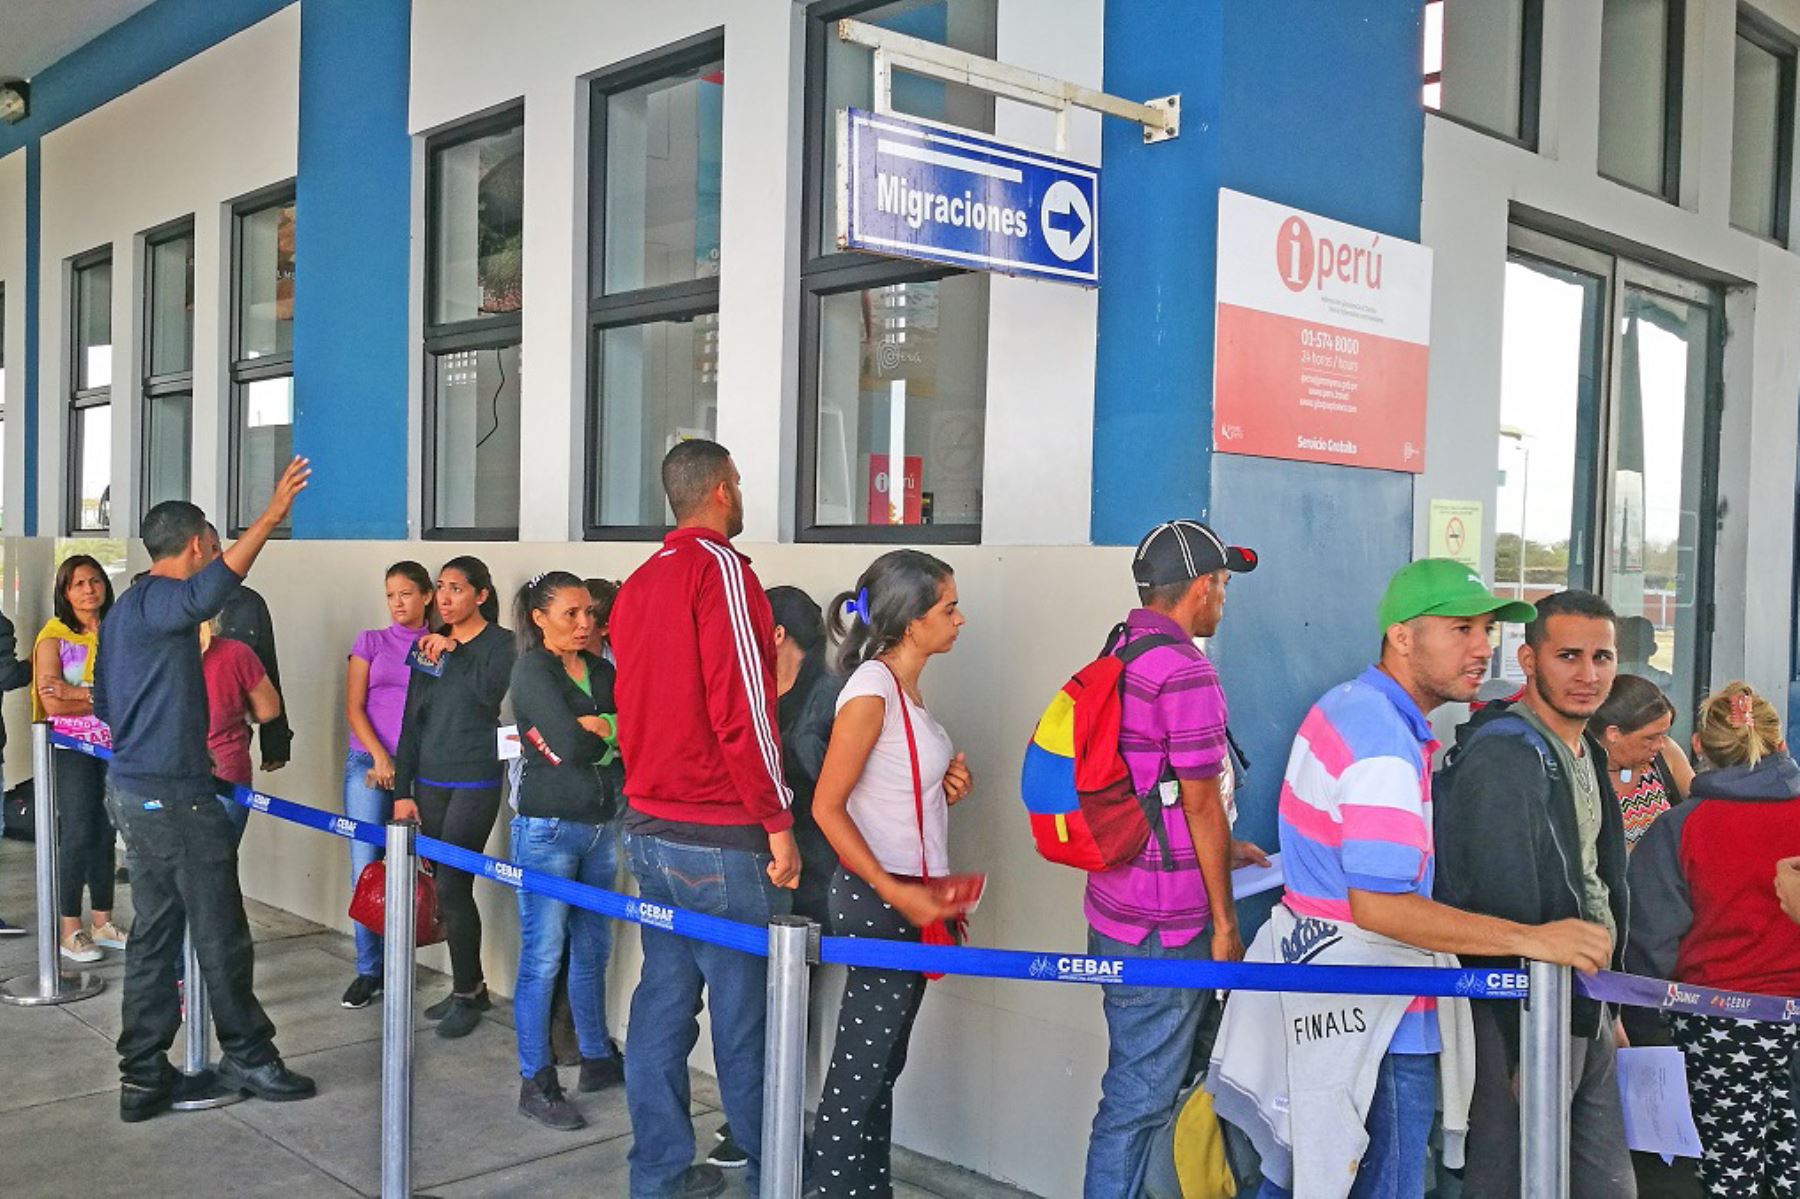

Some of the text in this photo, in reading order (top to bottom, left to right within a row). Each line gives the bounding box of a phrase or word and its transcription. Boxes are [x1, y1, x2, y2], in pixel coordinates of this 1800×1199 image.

[877, 173, 1028, 237] Migraciones
[1301, 328, 1360, 355] 01-574 8000
[495, 862, 522, 880] CEBAF
[640, 902, 673, 920] CEBAF
[1057, 958, 1124, 975] CEBAF
[1486, 973, 1529, 989] CEB
[1294, 1007, 1367, 1045] FINALS
